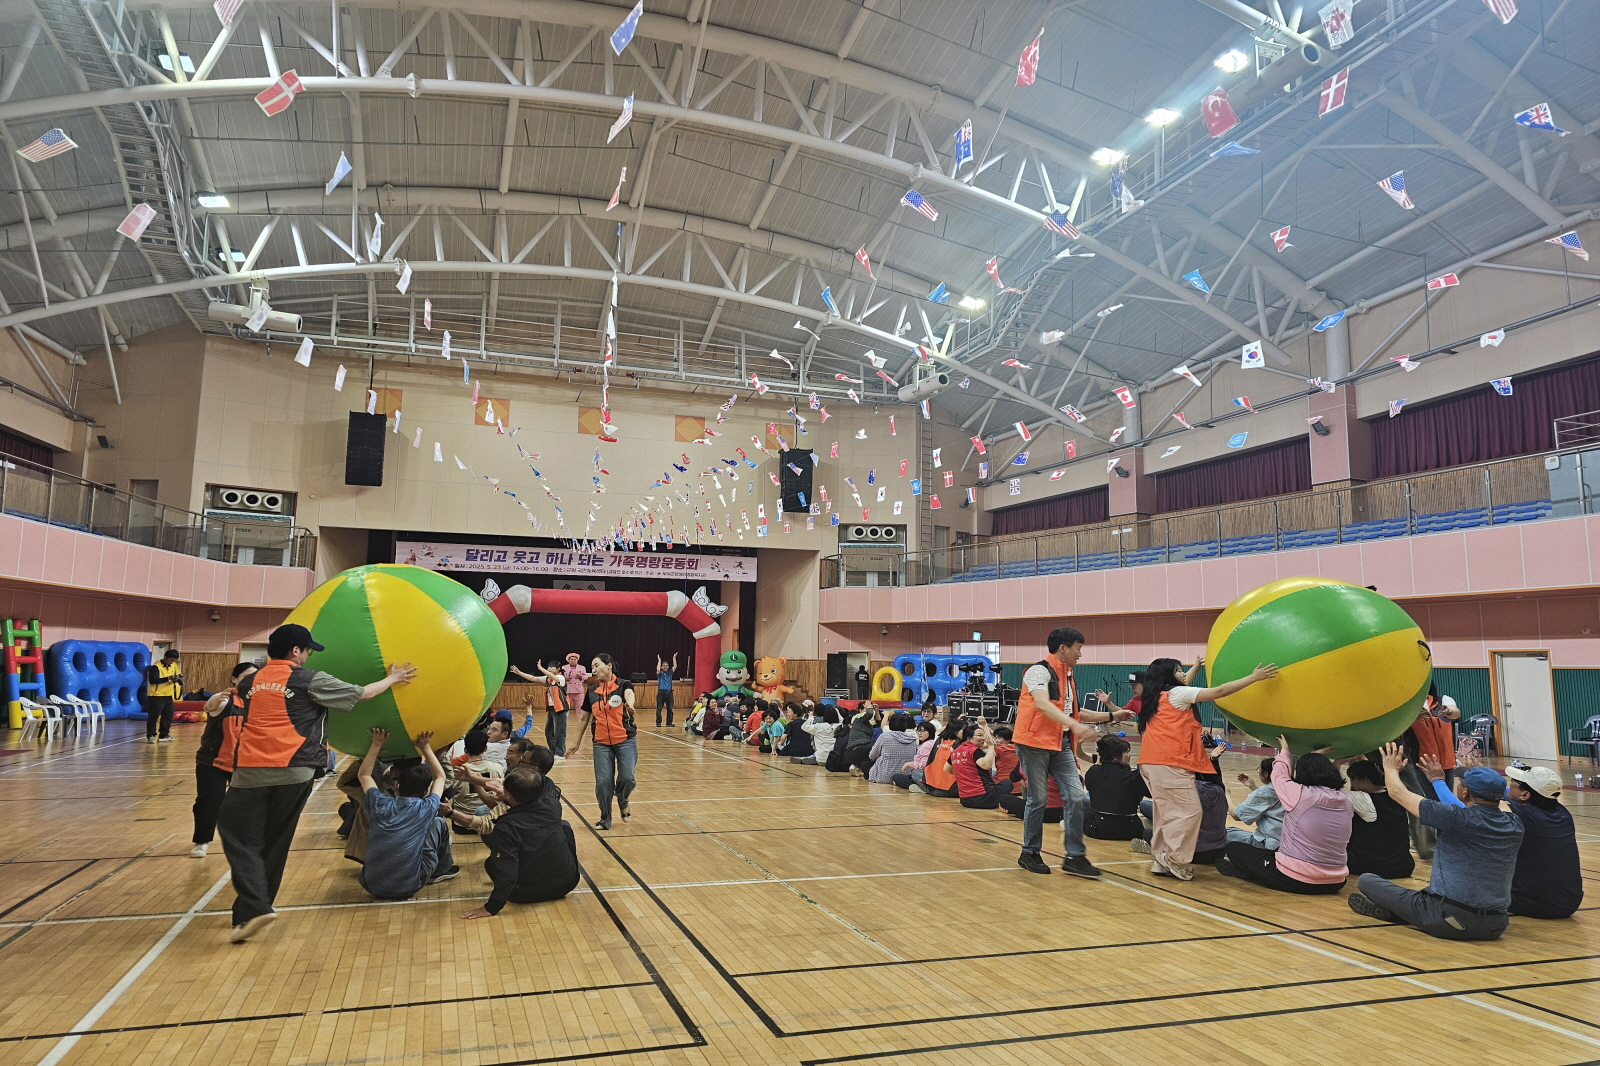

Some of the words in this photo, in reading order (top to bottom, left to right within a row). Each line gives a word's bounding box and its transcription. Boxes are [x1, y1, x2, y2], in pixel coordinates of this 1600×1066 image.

[465, 548, 508, 563] 달리고
[512, 550, 541, 564] 웃고
[545, 552, 574, 566] 하나
[577, 553, 605, 567] 되는
[609, 555, 699, 570] 가족명랑운동회
